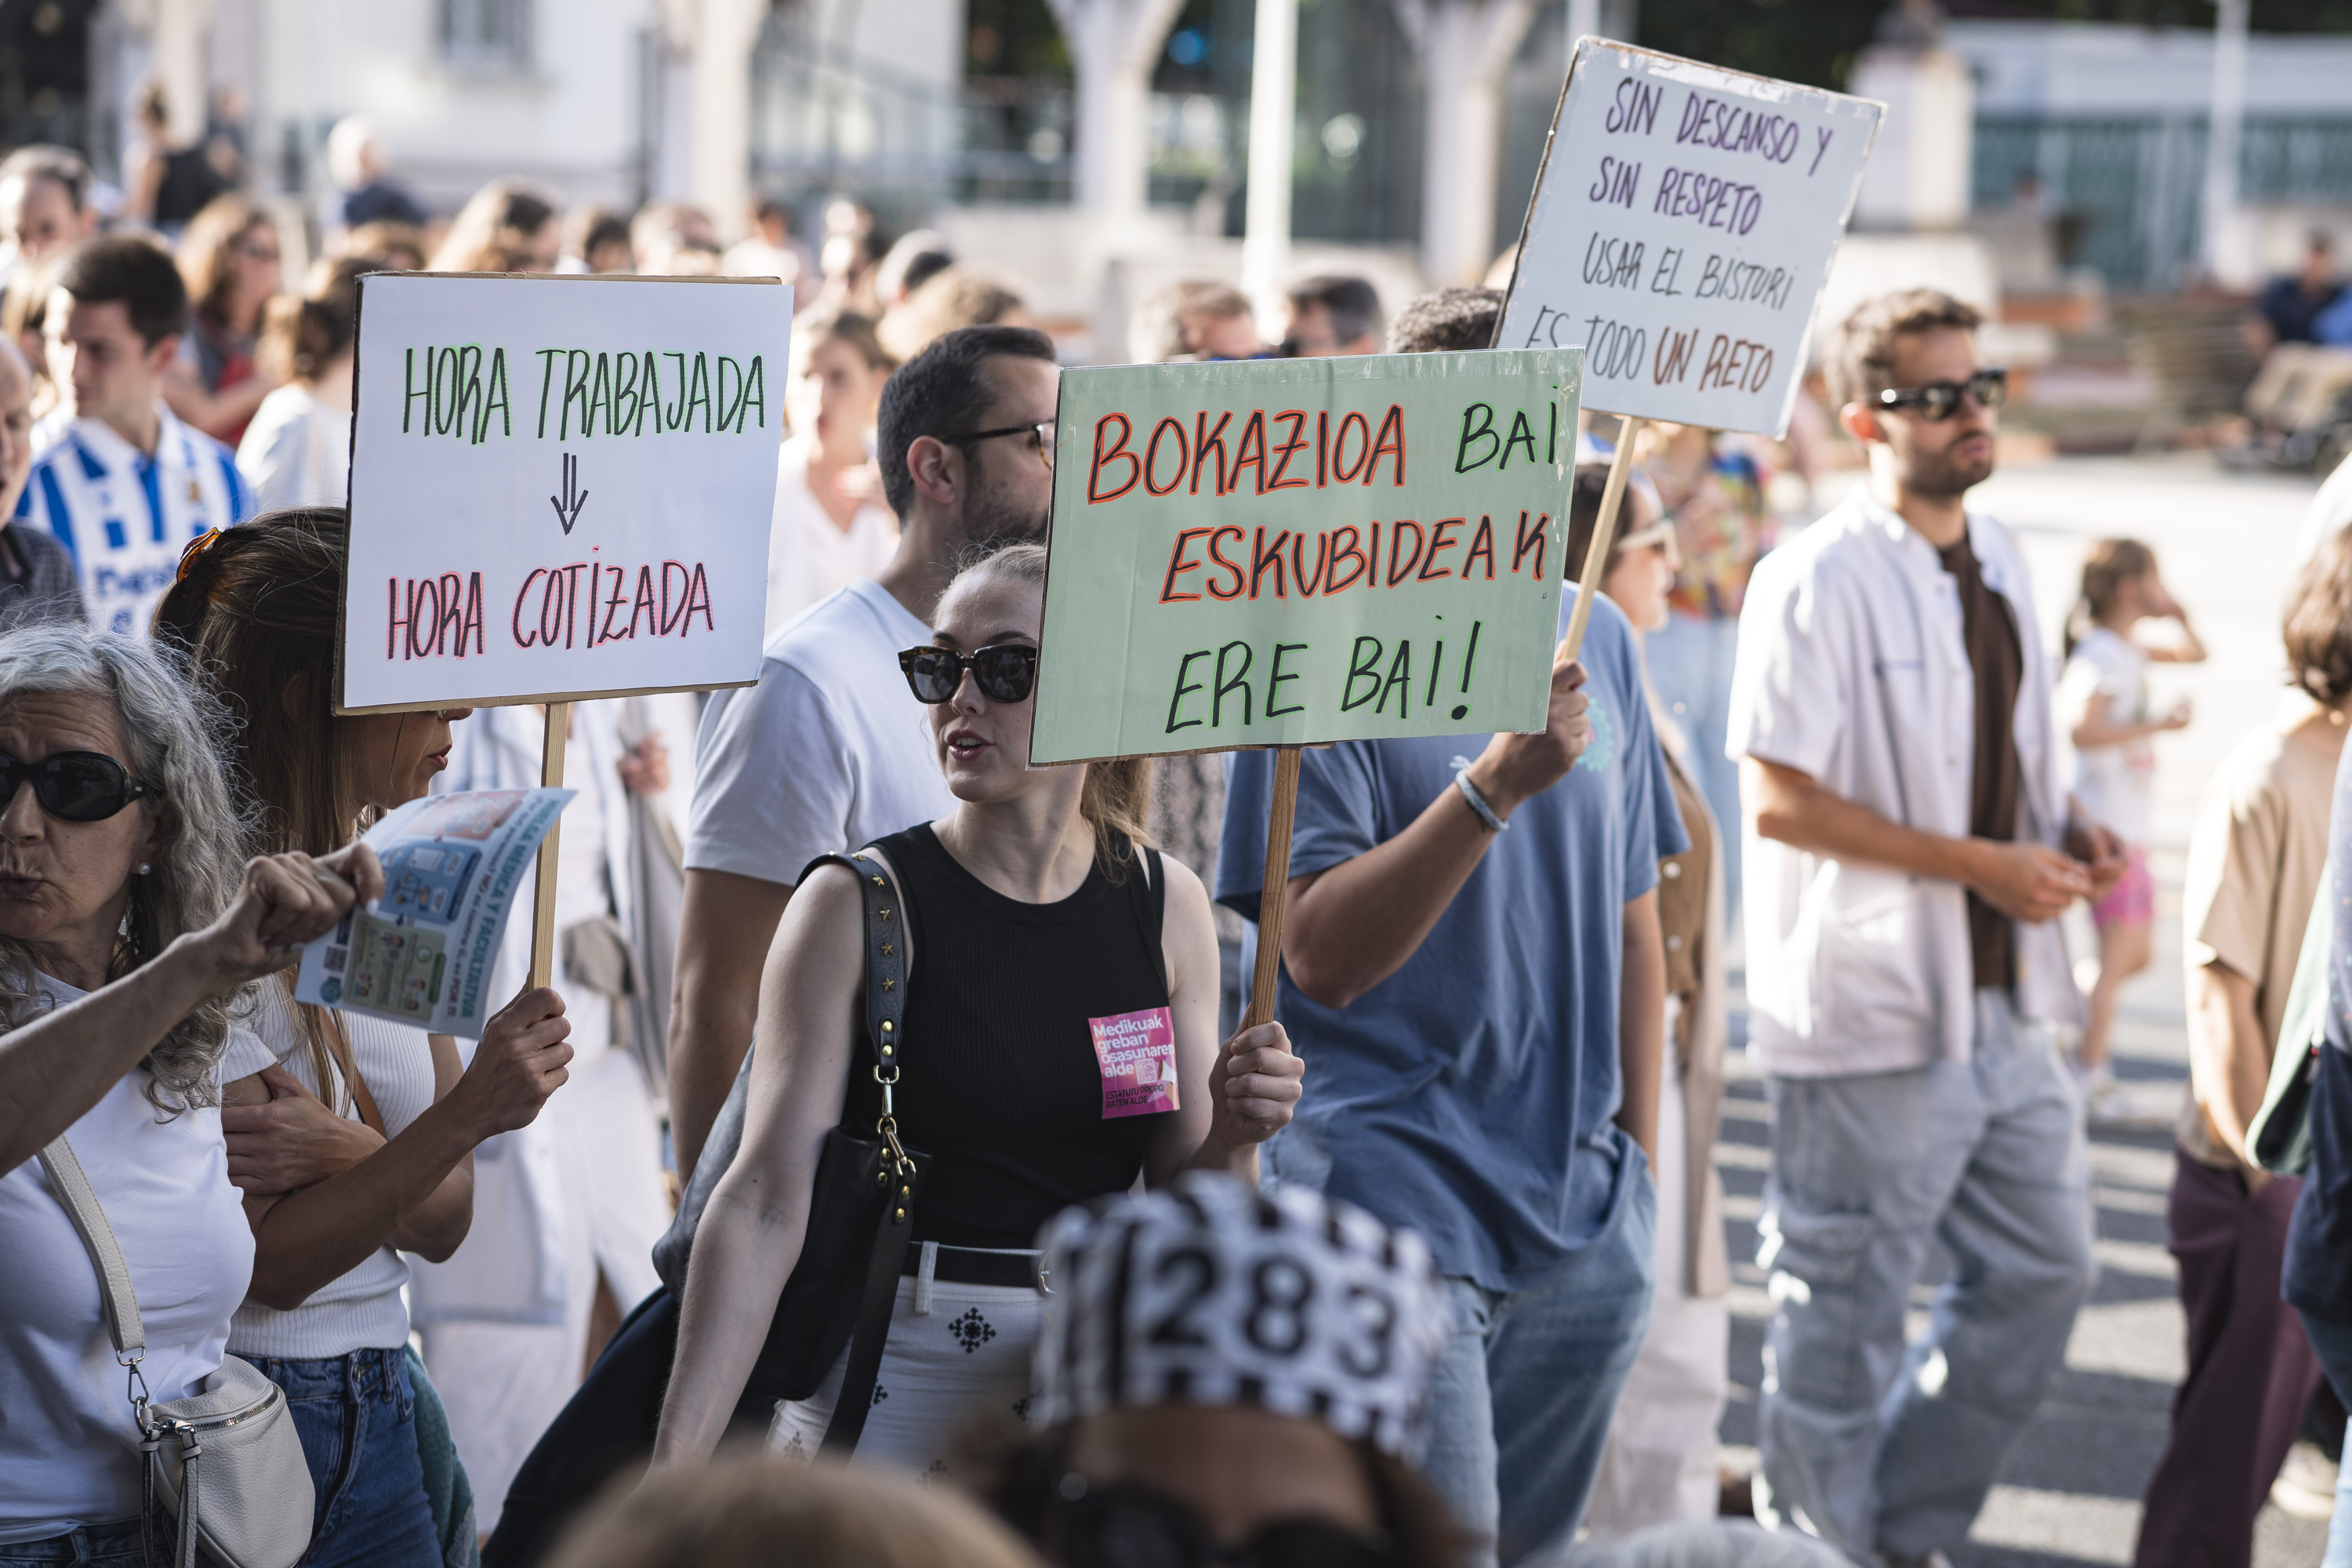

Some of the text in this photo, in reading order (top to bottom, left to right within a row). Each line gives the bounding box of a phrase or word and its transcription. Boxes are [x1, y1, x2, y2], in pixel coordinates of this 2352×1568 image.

[1605, 77, 1834, 178] SIN DESCANSO Y
[1589, 156, 1762, 236] SIN RESPETO
[1582, 232, 1644, 291] USAR
[1651, 248, 1684, 296] EL
[1584, 315, 1646, 379] TODO
[1653, 326, 1700, 387] UN
[1698, 333, 1774, 394] RETO
[403, 345, 765, 445] HORA TRABAJADA
[1087, 404, 1405, 505] BOKAZIOA
[1158, 510, 1551, 604] ESKUBIDEAK
[387, 571, 485, 661] HORA
[1164, 640, 1308, 735] ERE
[486, 902, 502, 916] Y
[1092, 1014, 1164, 1038] Medikuak
[1097, 1033, 1149, 1054] greban
[1100, 1043, 1175, 1064] osasunaren
[1104, 1062, 1135, 1078] alde
[1105, 1083, 1165, 1100] ESTATUTU PROPIO
[1105, 1094, 1149, 1109] BATEN ALDE
